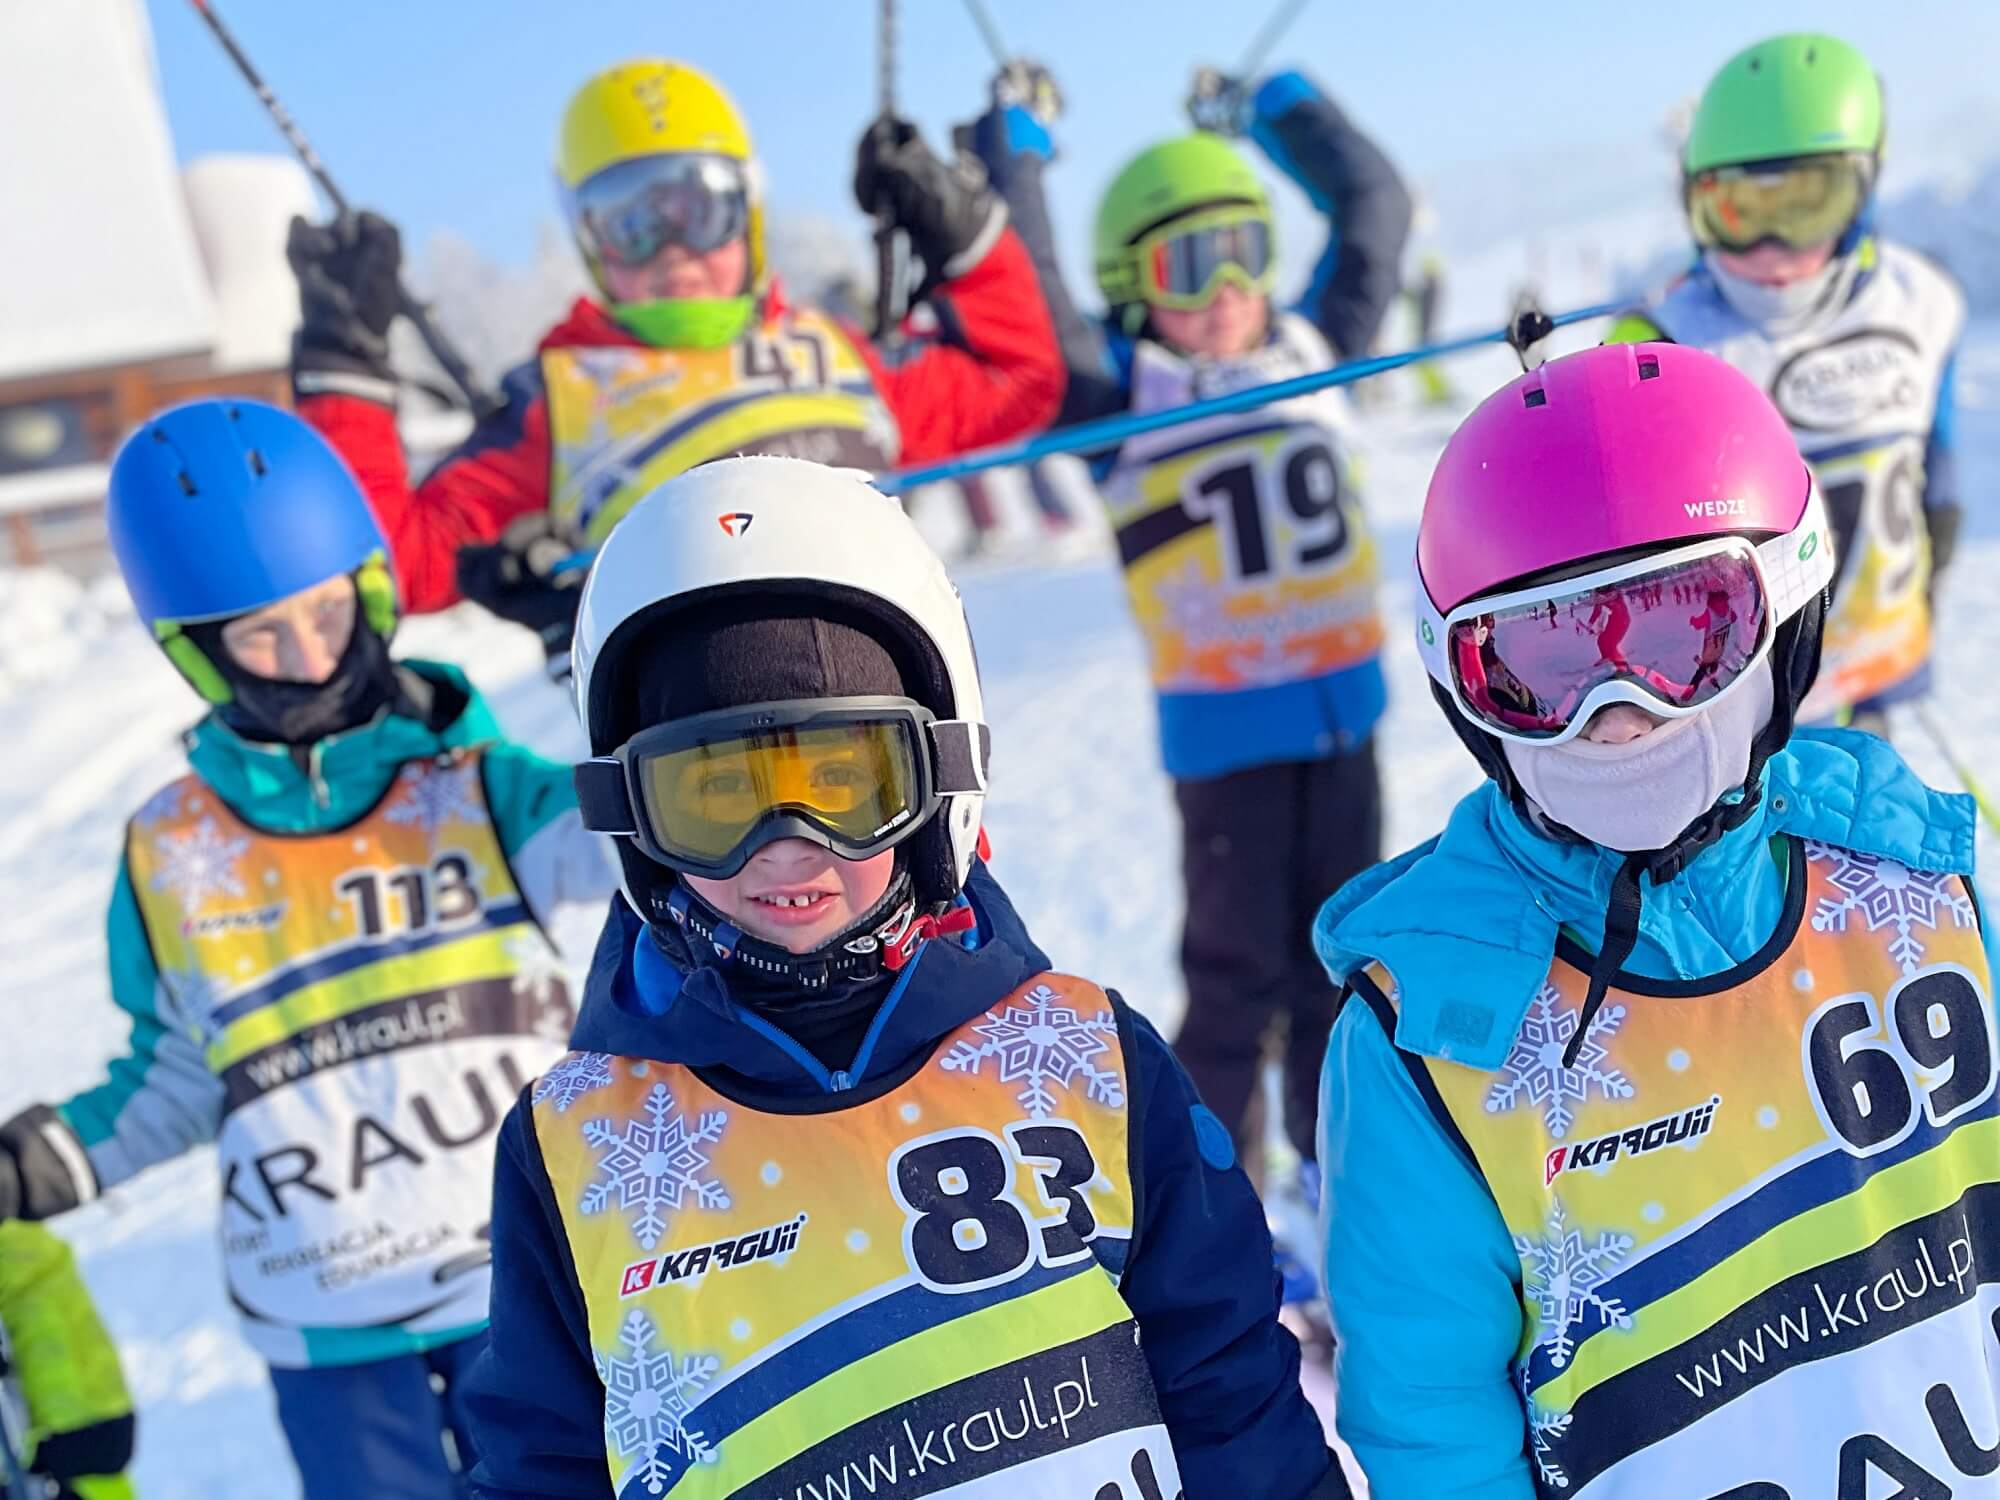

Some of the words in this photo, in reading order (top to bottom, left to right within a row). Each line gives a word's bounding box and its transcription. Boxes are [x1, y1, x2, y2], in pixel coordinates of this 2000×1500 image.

[1199, 444, 1349, 578] 19
[1683, 499, 1746, 519] WEDZE
[341, 855, 479, 936] 113
[1806, 967, 1993, 1153] 69
[894, 1122, 1098, 1289] 83
[1675, 1214, 1975, 1398] www.kraul.pl
